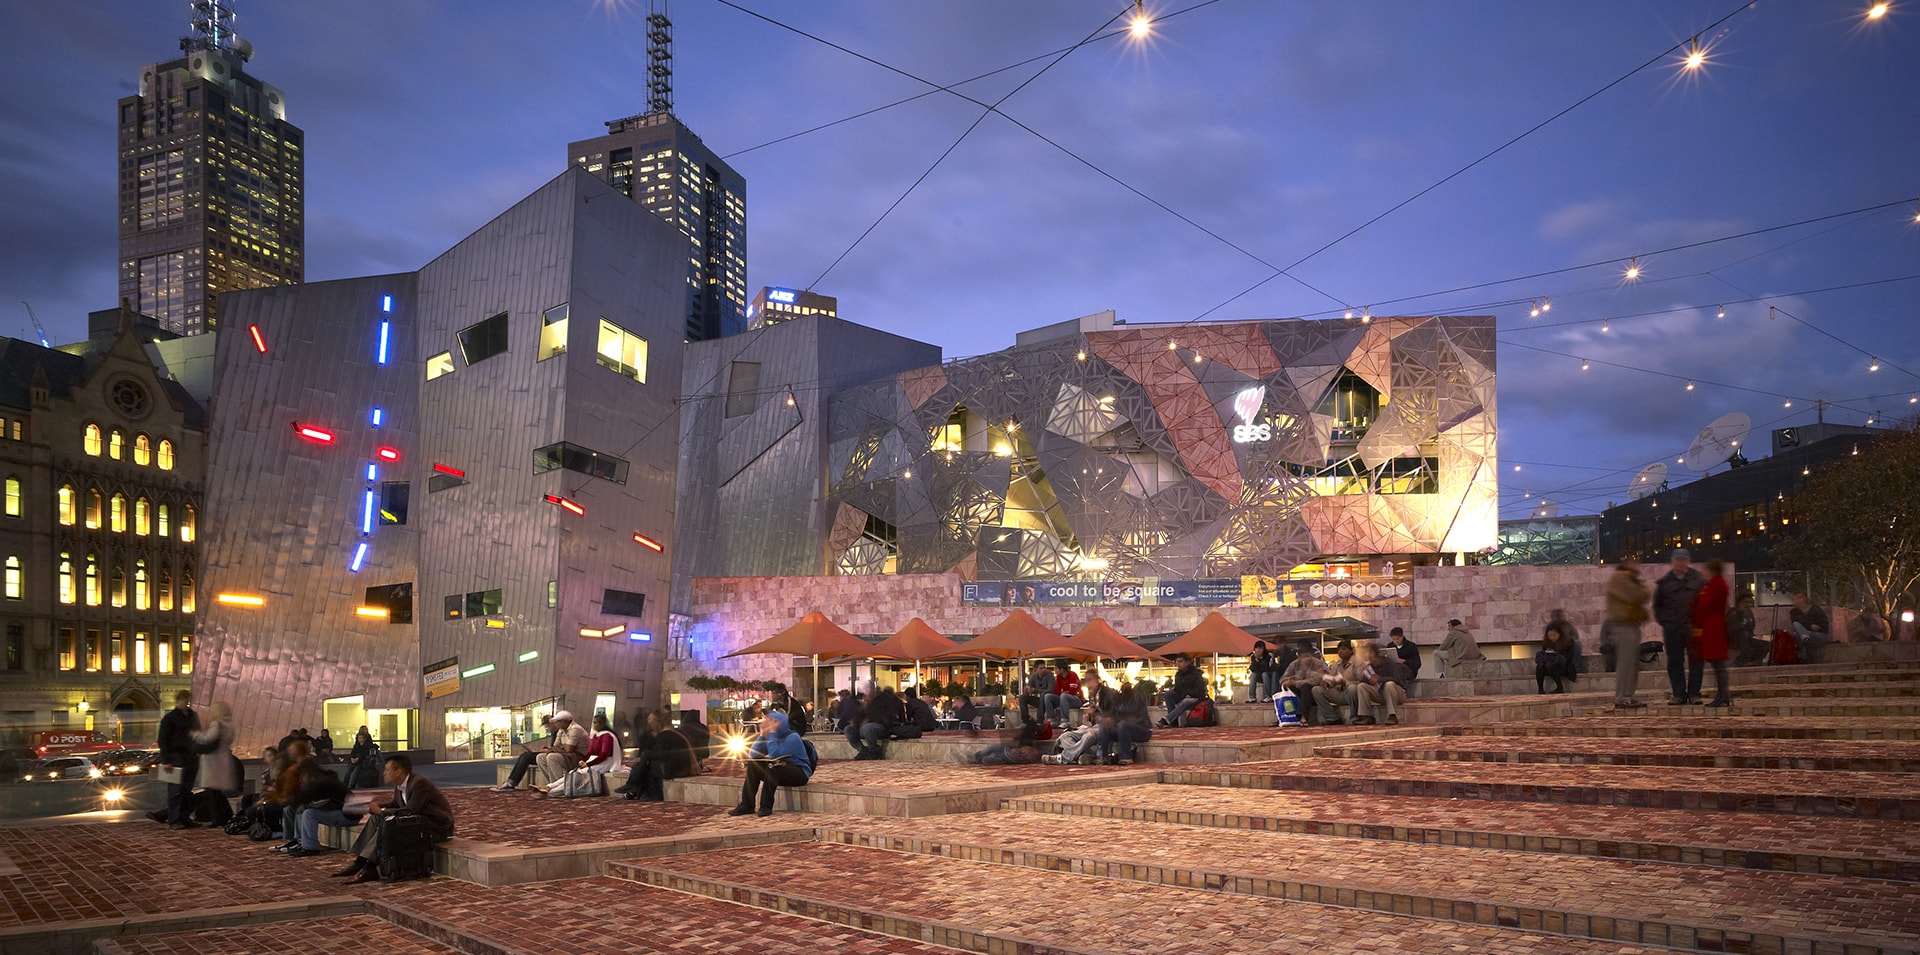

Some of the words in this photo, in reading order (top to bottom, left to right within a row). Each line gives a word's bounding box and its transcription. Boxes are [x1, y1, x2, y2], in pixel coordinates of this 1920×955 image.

[1049, 585, 1078, 597] cool
[1083, 586, 1097, 597] to
[1103, 584, 1121, 597] be
[1126, 586, 1175, 599] square
